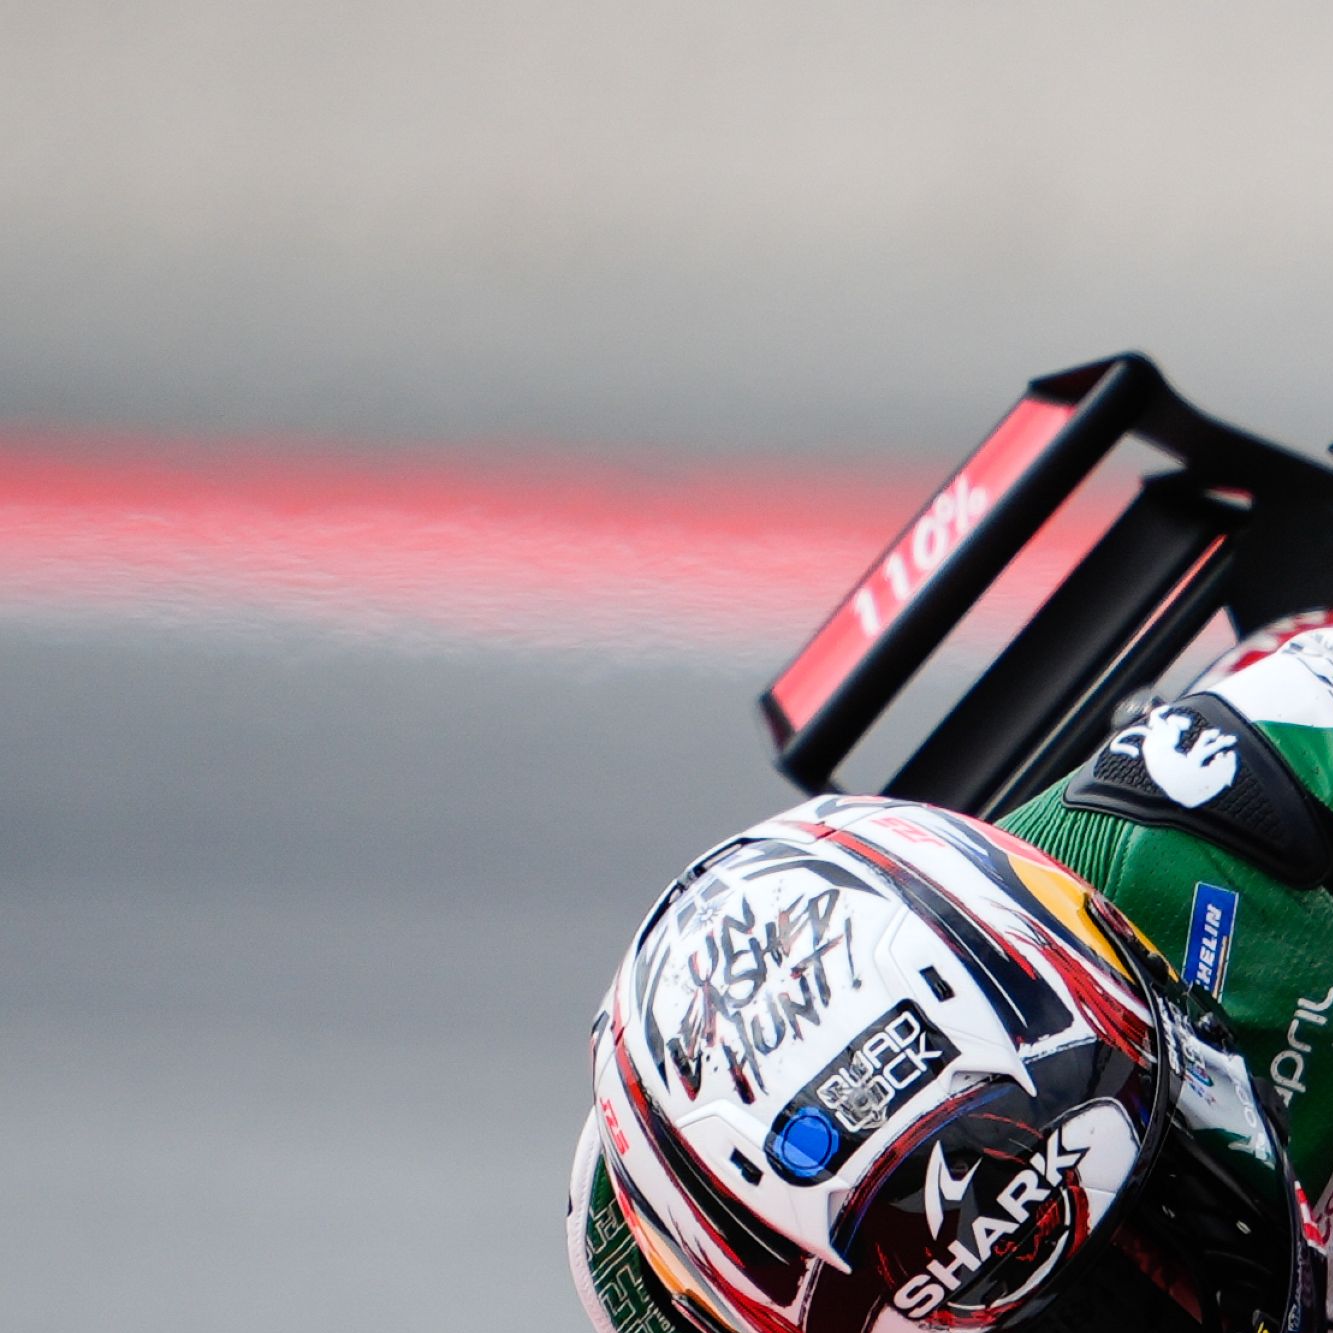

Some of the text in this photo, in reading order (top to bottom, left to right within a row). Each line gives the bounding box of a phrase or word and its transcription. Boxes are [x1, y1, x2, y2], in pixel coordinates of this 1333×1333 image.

[854, 470, 988, 638] 110%
[1195, 903, 1224, 992] HELIN
[816, 1010, 921, 1109] QUAD
[835, 1032, 943, 1133] LOCK
[893, 1132, 1091, 1319] SHARK
